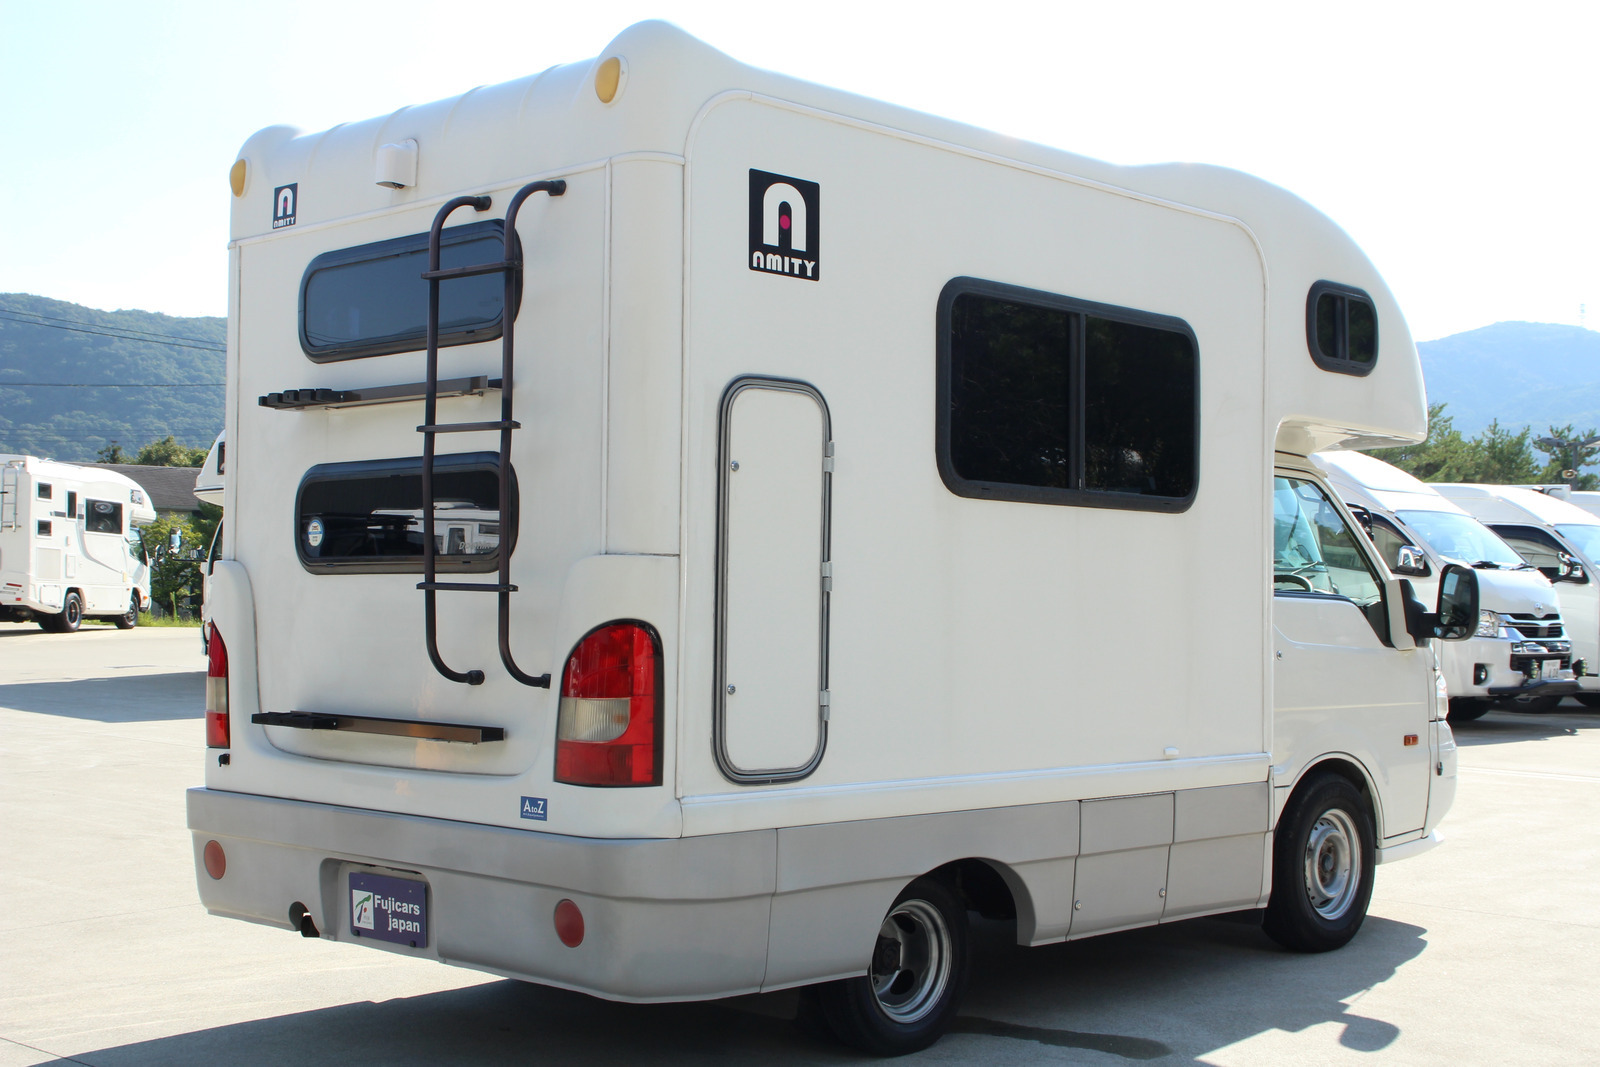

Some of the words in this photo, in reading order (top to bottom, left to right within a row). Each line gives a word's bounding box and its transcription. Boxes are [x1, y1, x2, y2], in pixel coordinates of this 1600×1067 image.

[274, 217, 295, 228] AMITY
[752, 251, 816, 277] AMITY
[374, 895, 420, 915] Fujicars
[388, 915, 420, 933] japan
